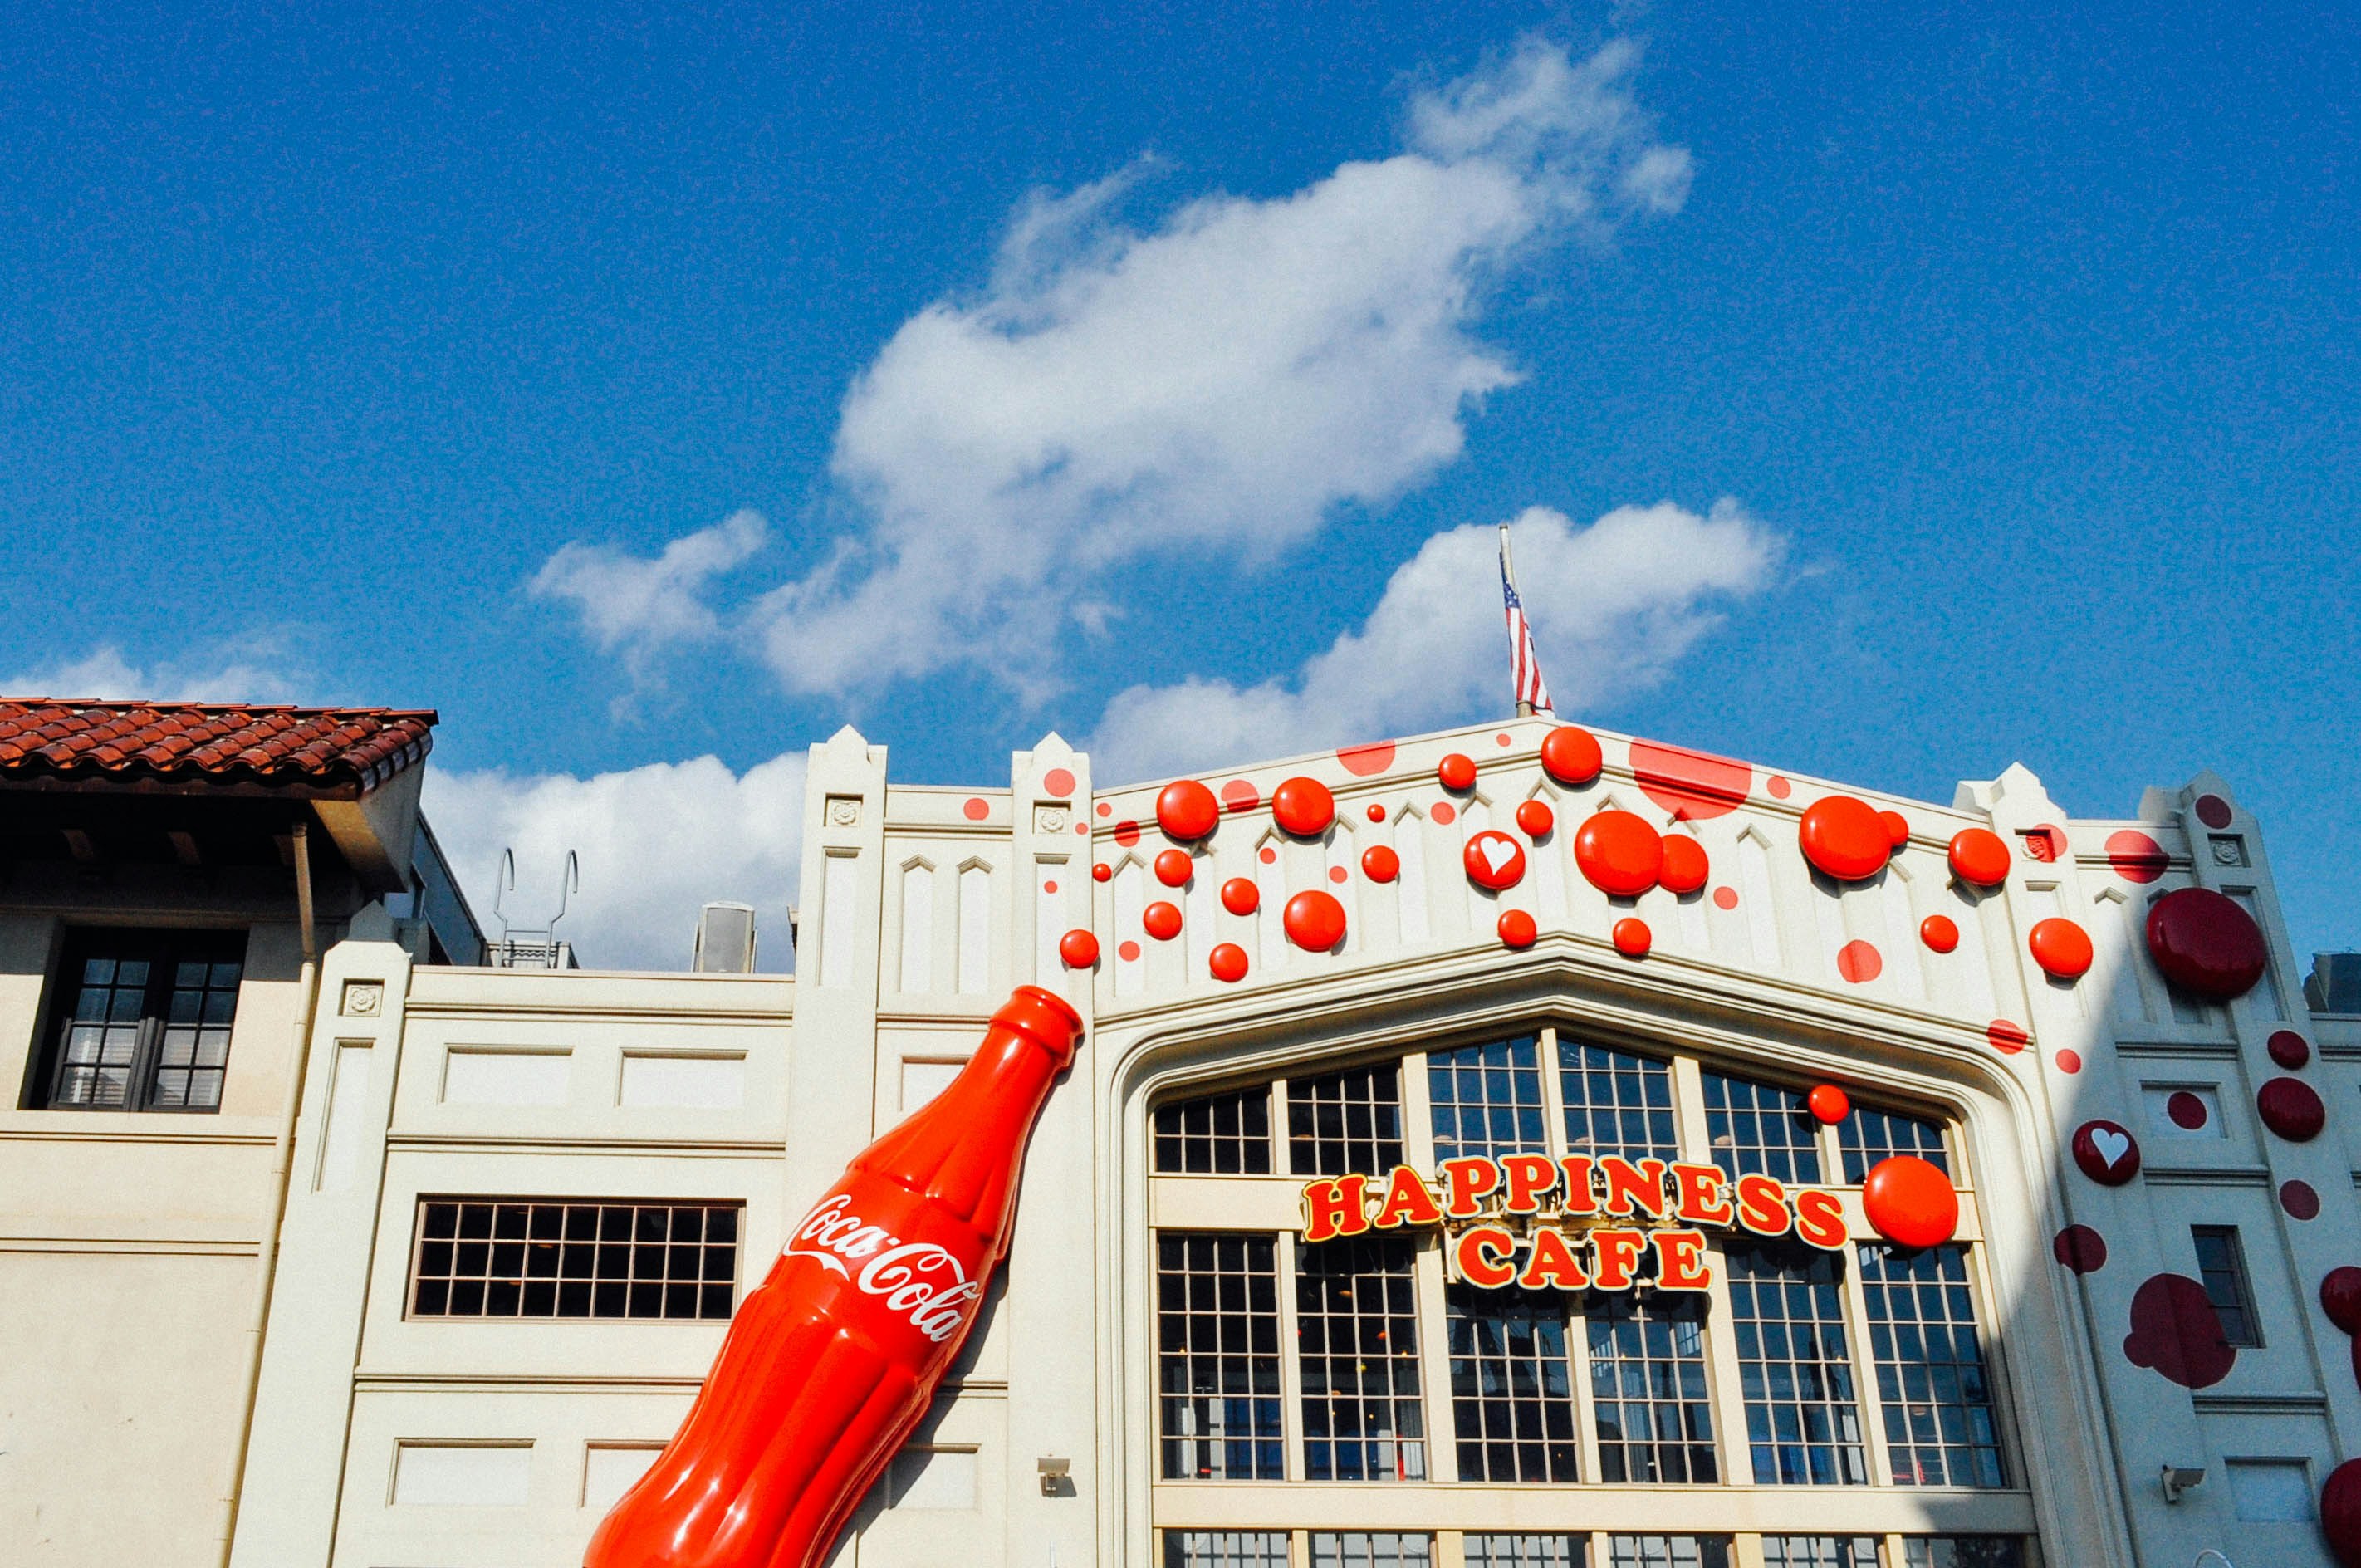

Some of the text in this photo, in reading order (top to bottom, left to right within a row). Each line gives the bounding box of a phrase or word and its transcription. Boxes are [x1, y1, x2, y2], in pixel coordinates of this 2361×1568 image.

[1302, 1153, 1849, 1250] HAPPINESS
[783, 1194, 980, 1342] Coca-Cola
[1455, 1226, 1712, 1291] CAFE
